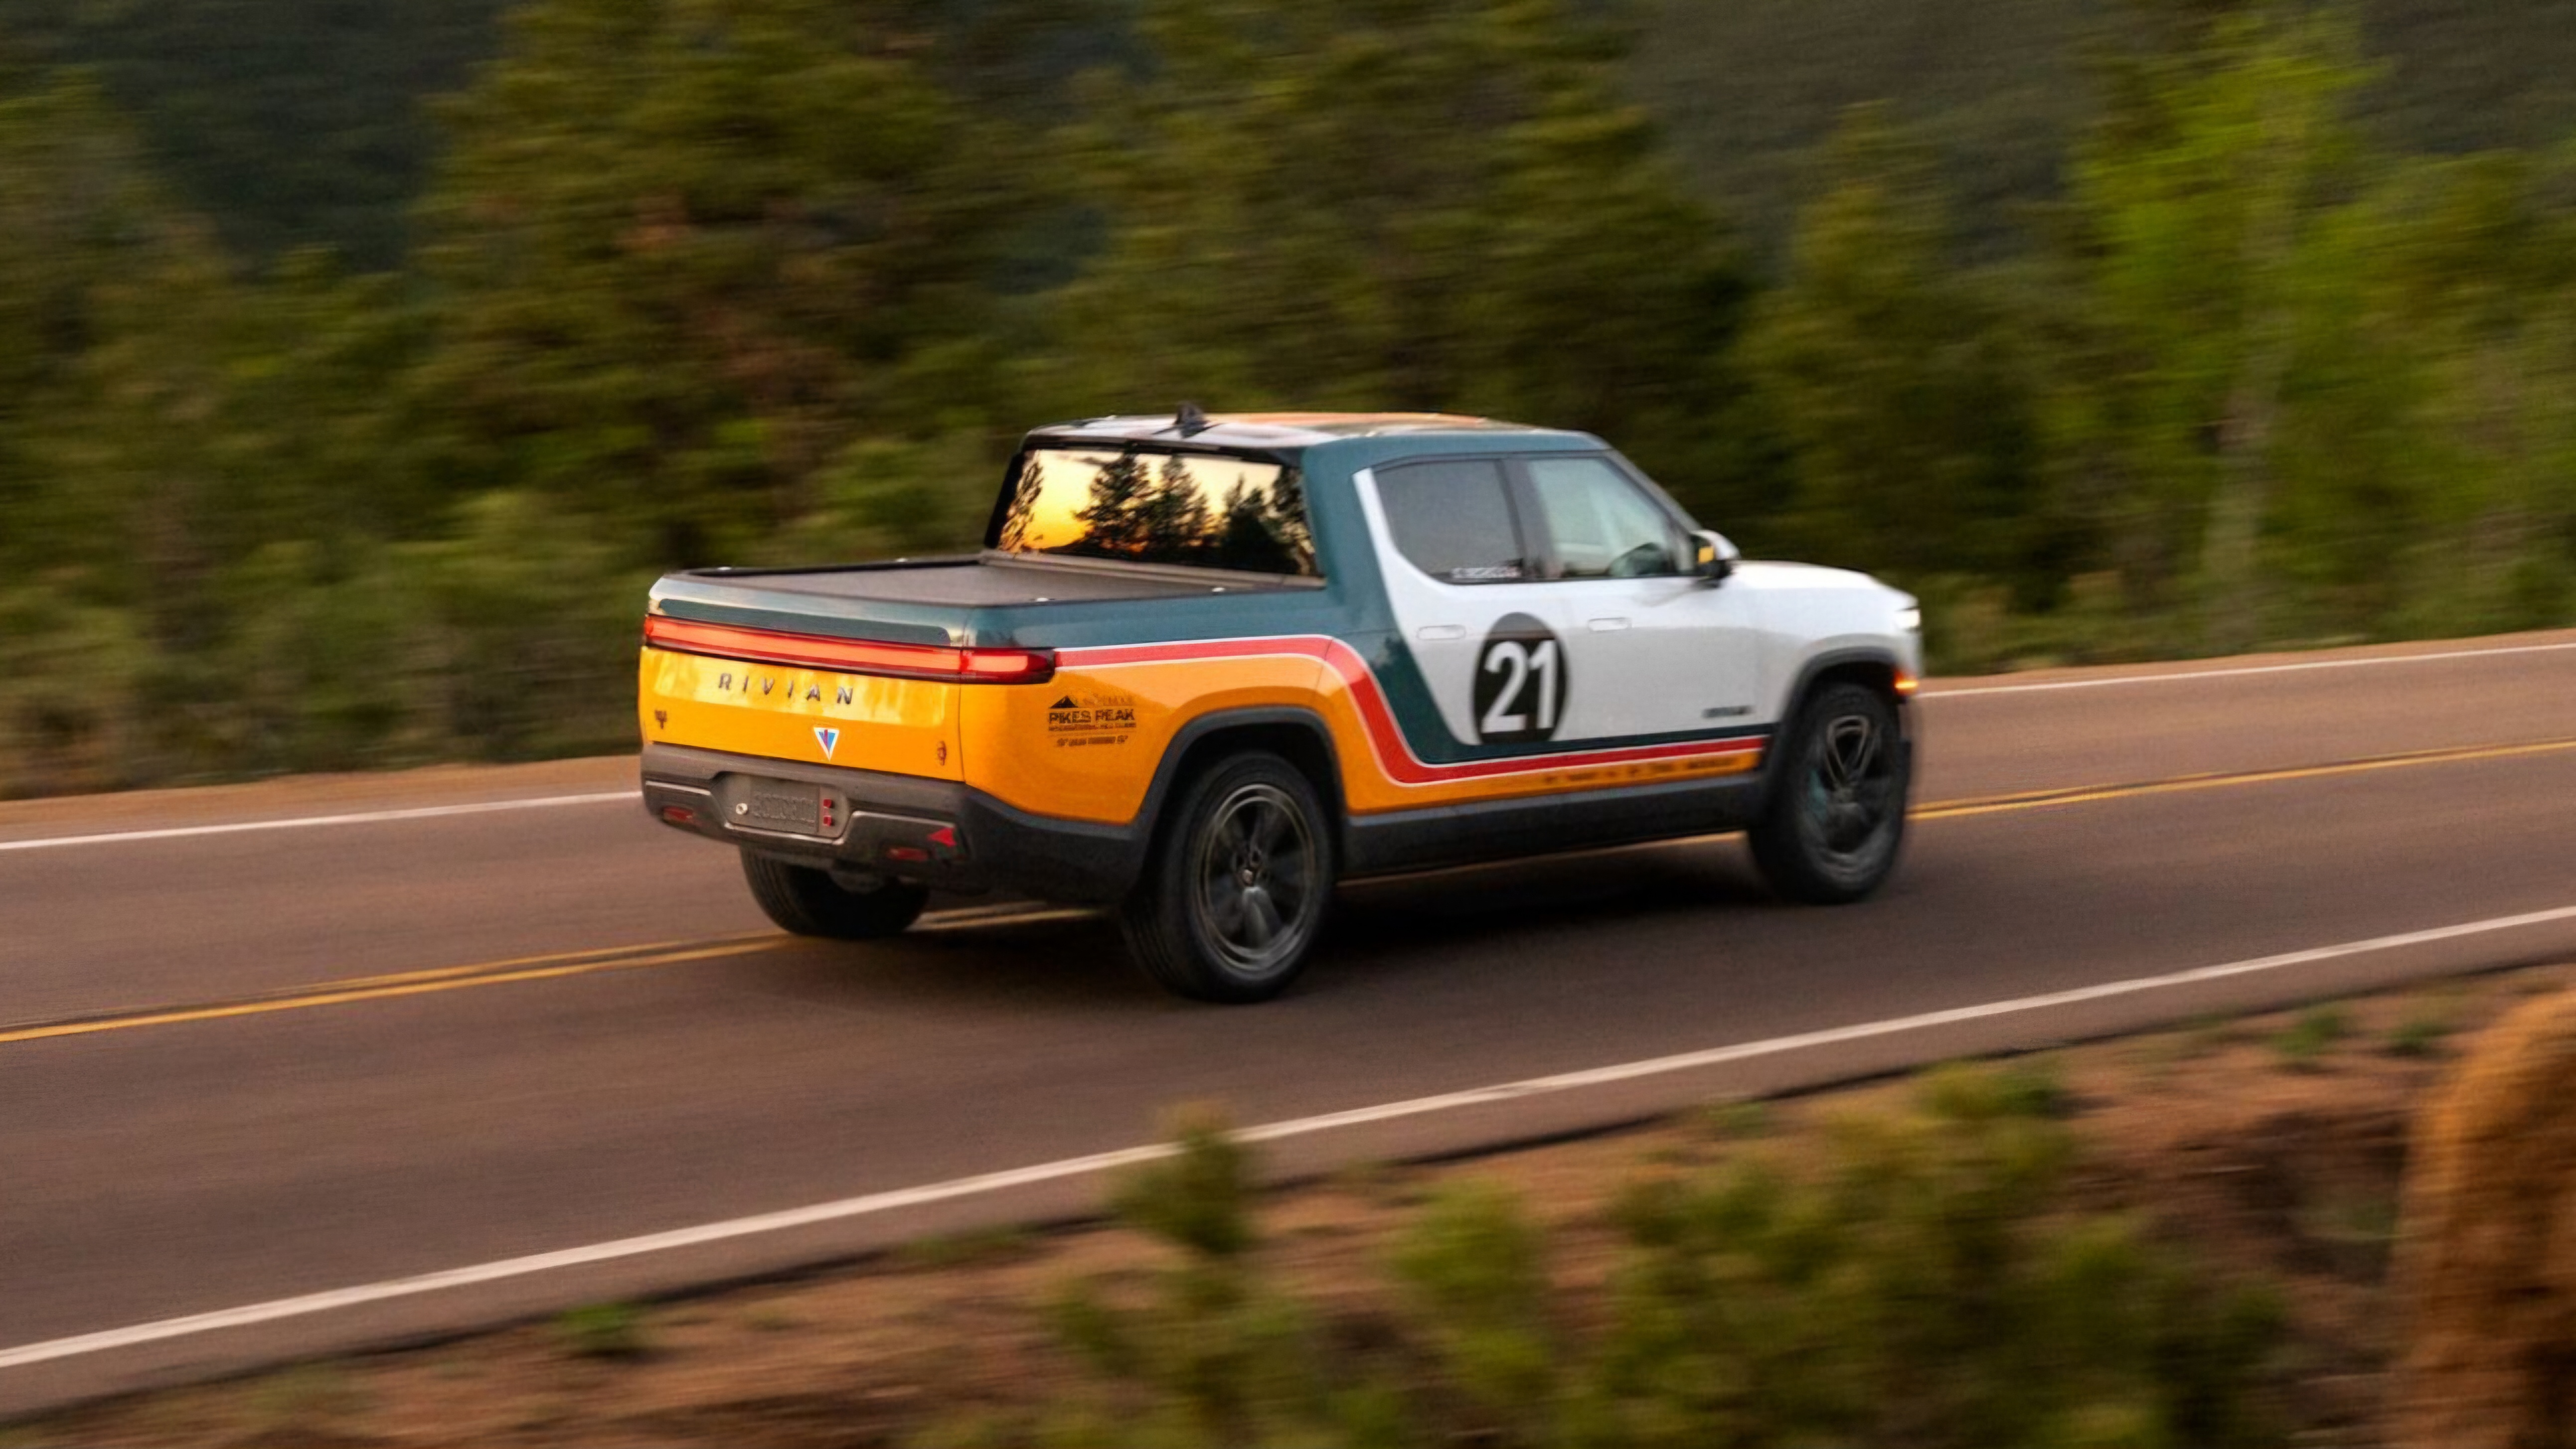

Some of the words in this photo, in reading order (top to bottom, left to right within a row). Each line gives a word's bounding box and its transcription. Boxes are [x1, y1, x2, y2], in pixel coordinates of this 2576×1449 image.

[718, 673, 854, 705] RIVIAN
[1481, 640, 1556, 732] 21
[1049, 712, 1091, 724] PIKES
[1095, 708, 1135, 721] PEAK
